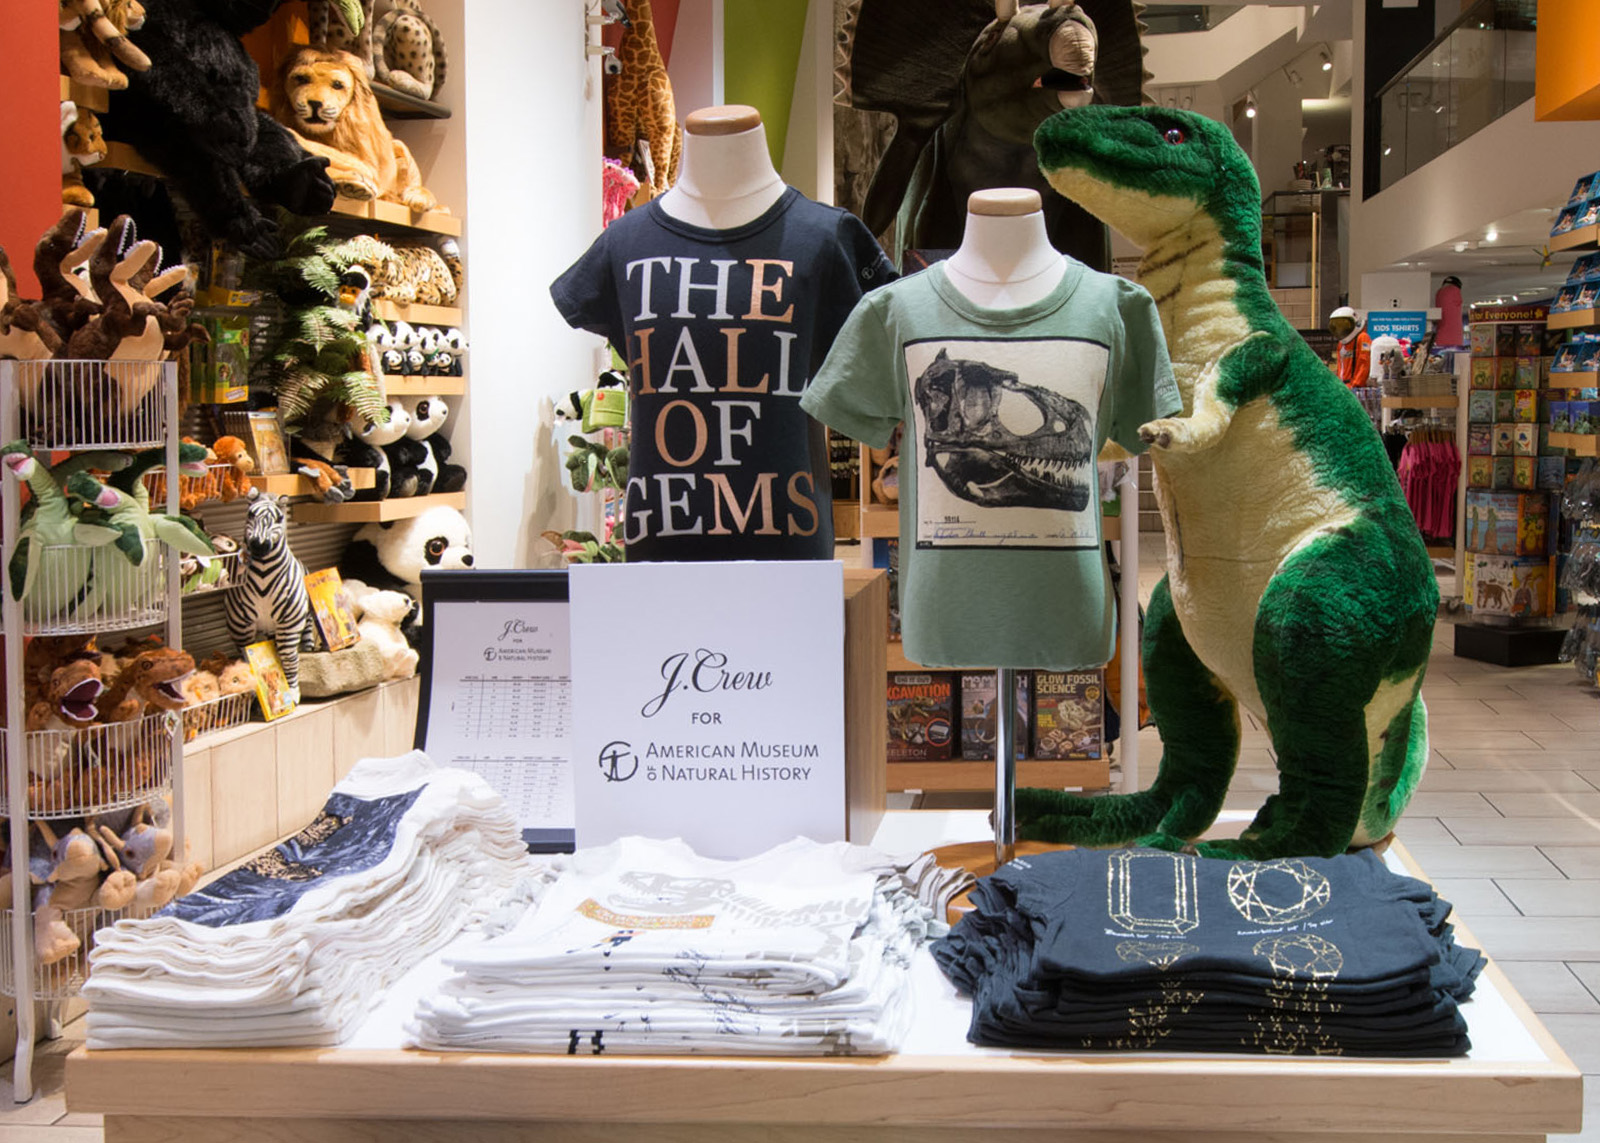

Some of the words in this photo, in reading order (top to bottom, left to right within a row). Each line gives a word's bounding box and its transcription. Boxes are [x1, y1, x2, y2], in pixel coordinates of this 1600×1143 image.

[626, 256, 794, 323] THE
[1485, 309, 1533, 320] Everyone!
[1373, 324, 1390, 332] KIDS
[626, 326, 808, 396] HALL
[655, 400, 760, 467] OF
[623, 471, 819, 545] GEMS
[640, 648, 773, 718] J.Crew
[1037, 674, 1065, 684] GLOW
[1067, 674, 1100, 684] FOSSIL
[1037, 684, 1077, 694] SCIENCE
[691, 712, 722, 725] FOR
[645, 742, 736, 759] AMERICAN
[740, 741, 819, 758] MUSEUM
[661, 764, 737, 781] NATURAL
[741, 764, 812, 781] HISTORY
